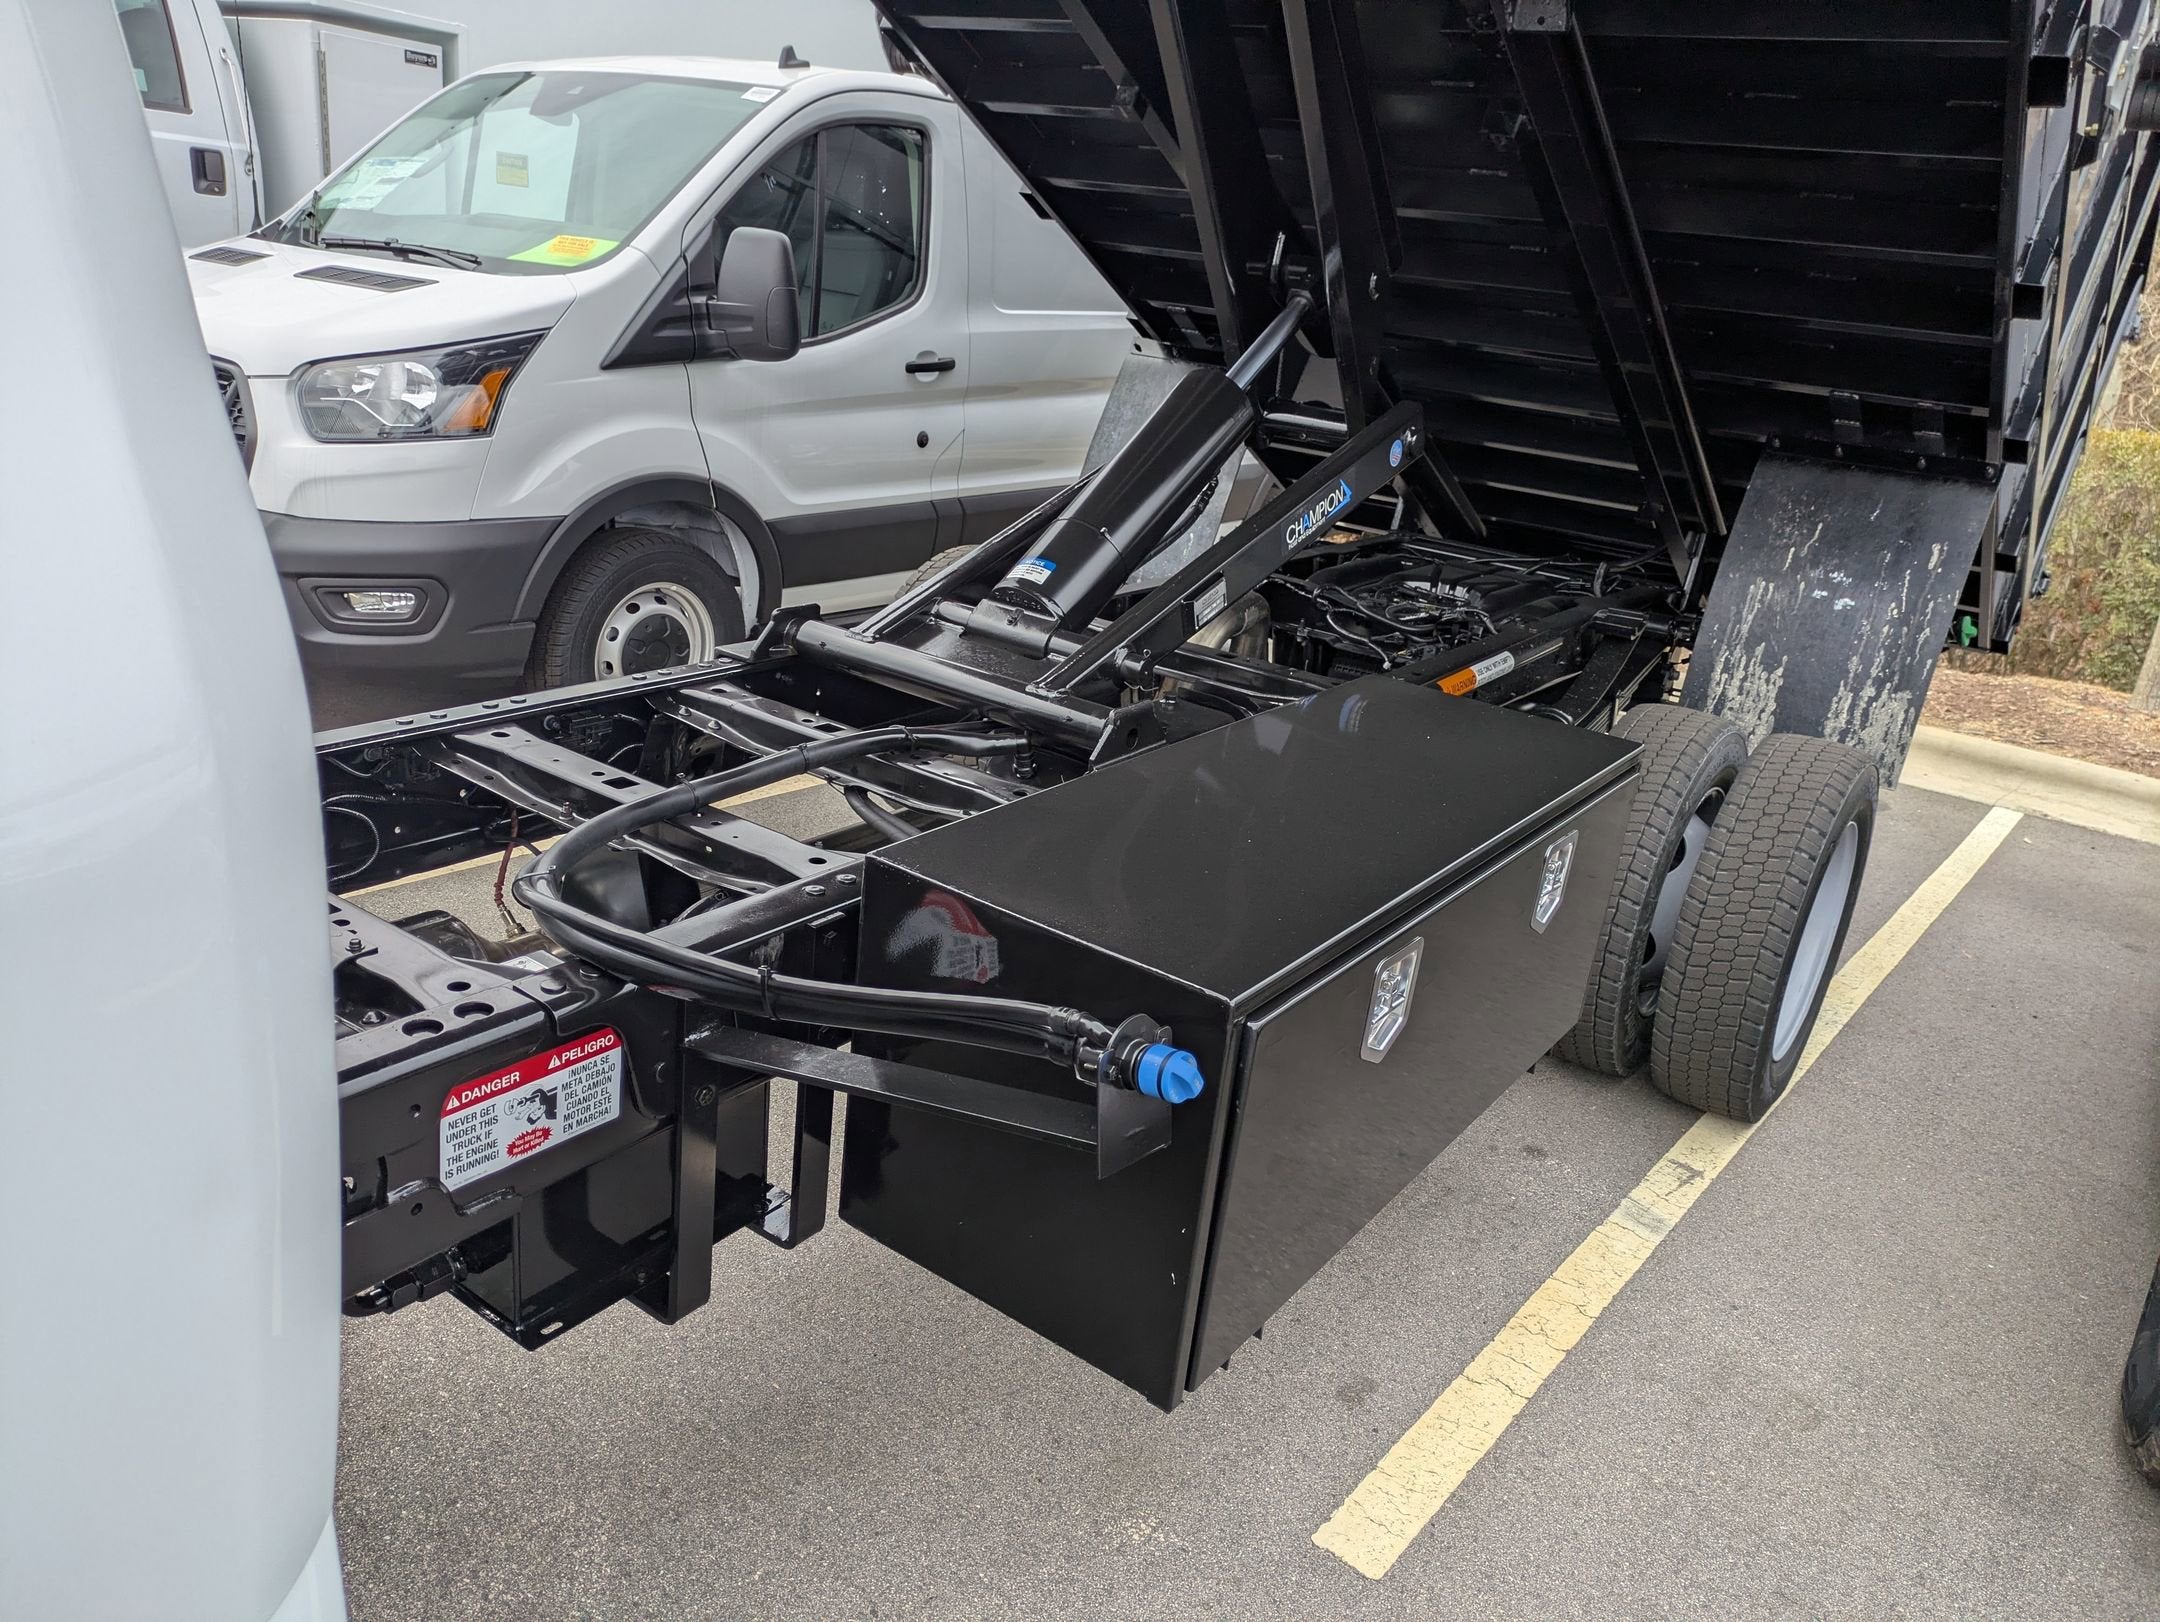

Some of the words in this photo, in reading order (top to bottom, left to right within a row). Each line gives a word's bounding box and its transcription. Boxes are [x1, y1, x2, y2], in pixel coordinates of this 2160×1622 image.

[1286, 486, 1344, 543] CHAMPION
[1298, 532, 1306, 542] and
[1305, 516, 1326, 537] Equipment
[1451, 675, 1477, 692] WARNING
[562, 1034, 614, 1063] PELIGRO
[600, 1055, 610, 1065] SE
[461, 1072, 520, 1104] DANGER
[561, 1079, 583, 1092] META
[585, 1063, 615, 1082] DEBAJO
[564, 1090, 579, 1101] DEL
[581, 1074, 612, 1094] CAMIÓN
[563, 1104, 591, 1123] MOTOR
[593, 1094, 612, 1110] ESTÉ
[566, 1091, 598, 1111] CUANDO
[600, 1087, 610, 1098] EL
[446, 1124, 477, 1143] UNDER
[479, 1115, 498, 1130] THIS
[448, 1112, 477, 1131] NEVER
[480, 1104, 496, 1118] GET
[563, 1122, 574, 1134] EN
[575, 1105, 612, 1128] MARCHA!
[452, 1134, 482, 1152] TRUCK
[484, 1129, 493, 1139] IF
[512, 1145, 524, 1154] Hurt
[530, 1136, 544, 1146] Killed
[524, 1133, 535, 1142] May
[445, 1169, 454, 1180] IS
[456, 1149, 500, 1175] RUNNING!
[446, 1153, 464, 1167] THE
[466, 1138, 498, 1158] ENGINE
